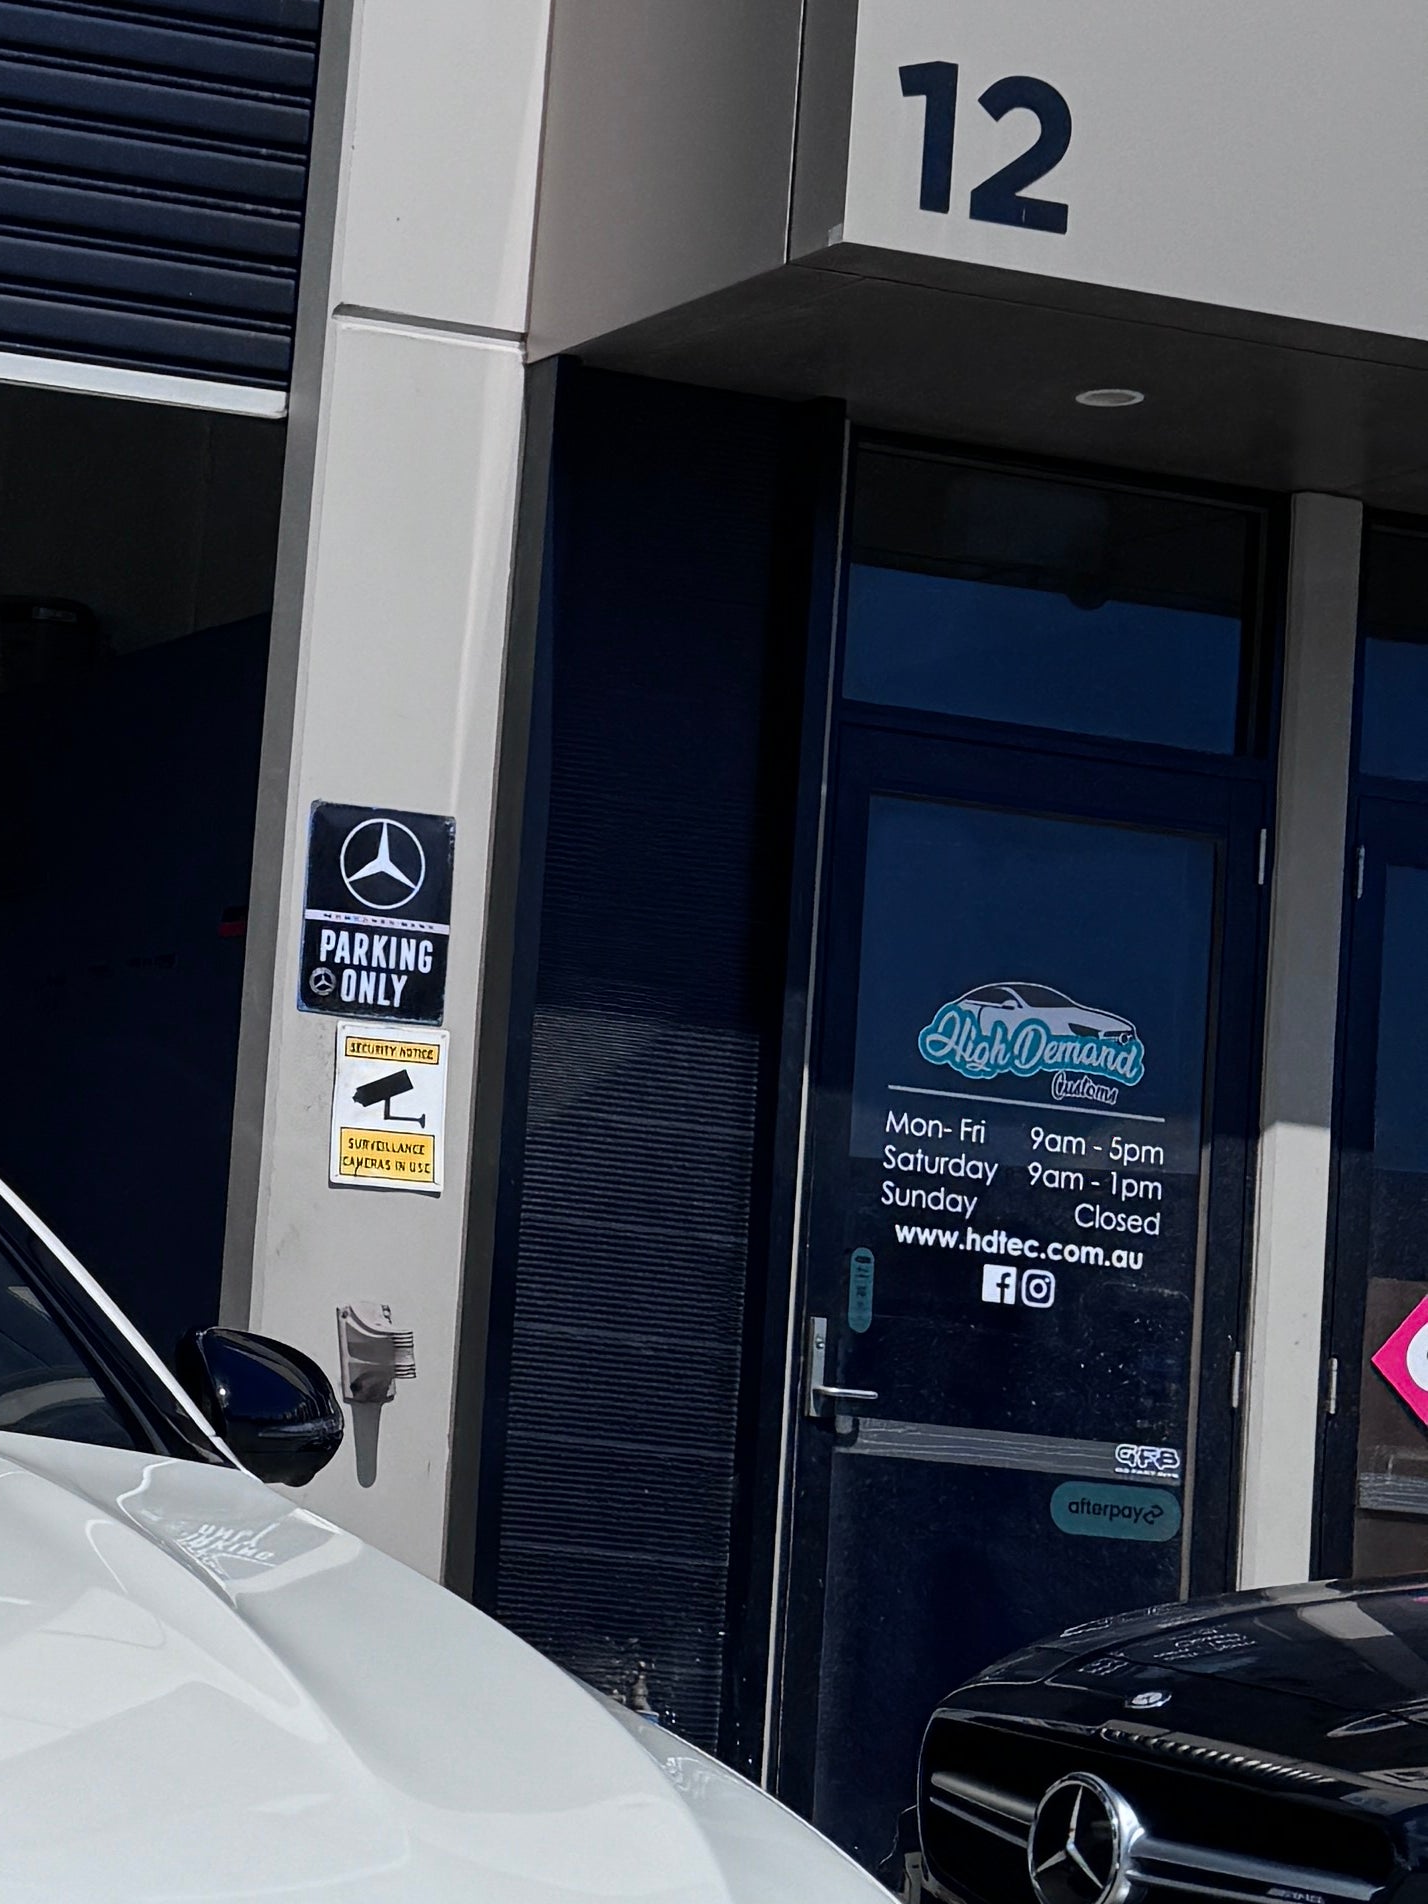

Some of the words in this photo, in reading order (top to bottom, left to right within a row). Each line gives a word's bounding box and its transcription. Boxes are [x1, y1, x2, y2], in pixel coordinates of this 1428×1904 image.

[898, 60, 1073, 235] 12
[319, 928, 434, 974] PARKING
[340, 968, 408, 1008] ONLY
[350, 1041, 397, 1057] SECURITY
[399, 1045, 434, 1061] NOTICE
[925, 1010, 1011, 1072] High
[1013, 1023, 1138, 1079] Demand
[1051, 1070, 1119, 1106] Customs
[347, 1137, 426, 1156] SURVEILLANCE
[885, 1110, 953, 1139] Mon-
[960, 1118, 986, 1144] Fri
[1030, 1126, 1086, 1156] 9am
[1108, 1136, 1164, 1166] 5pm
[342, 1155, 391, 1172] CAMERAS
[395, 1160, 406, 1172] IN
[409, 1162, 432, 1175] USE
[883, 1144, 999, 1187] Saturday
[1027, 1161, 1085, 1191] 9am
[1110, 1171, 1163, 1201] 1pm
[881, 1180, 978, 1220] Sunday
[1074, 1203, 1161, 1236] Closed
[894, 1222, 1144, 1270] www.hdtec.com.au
[1068, 1497, 1144, 1524] afterpay
